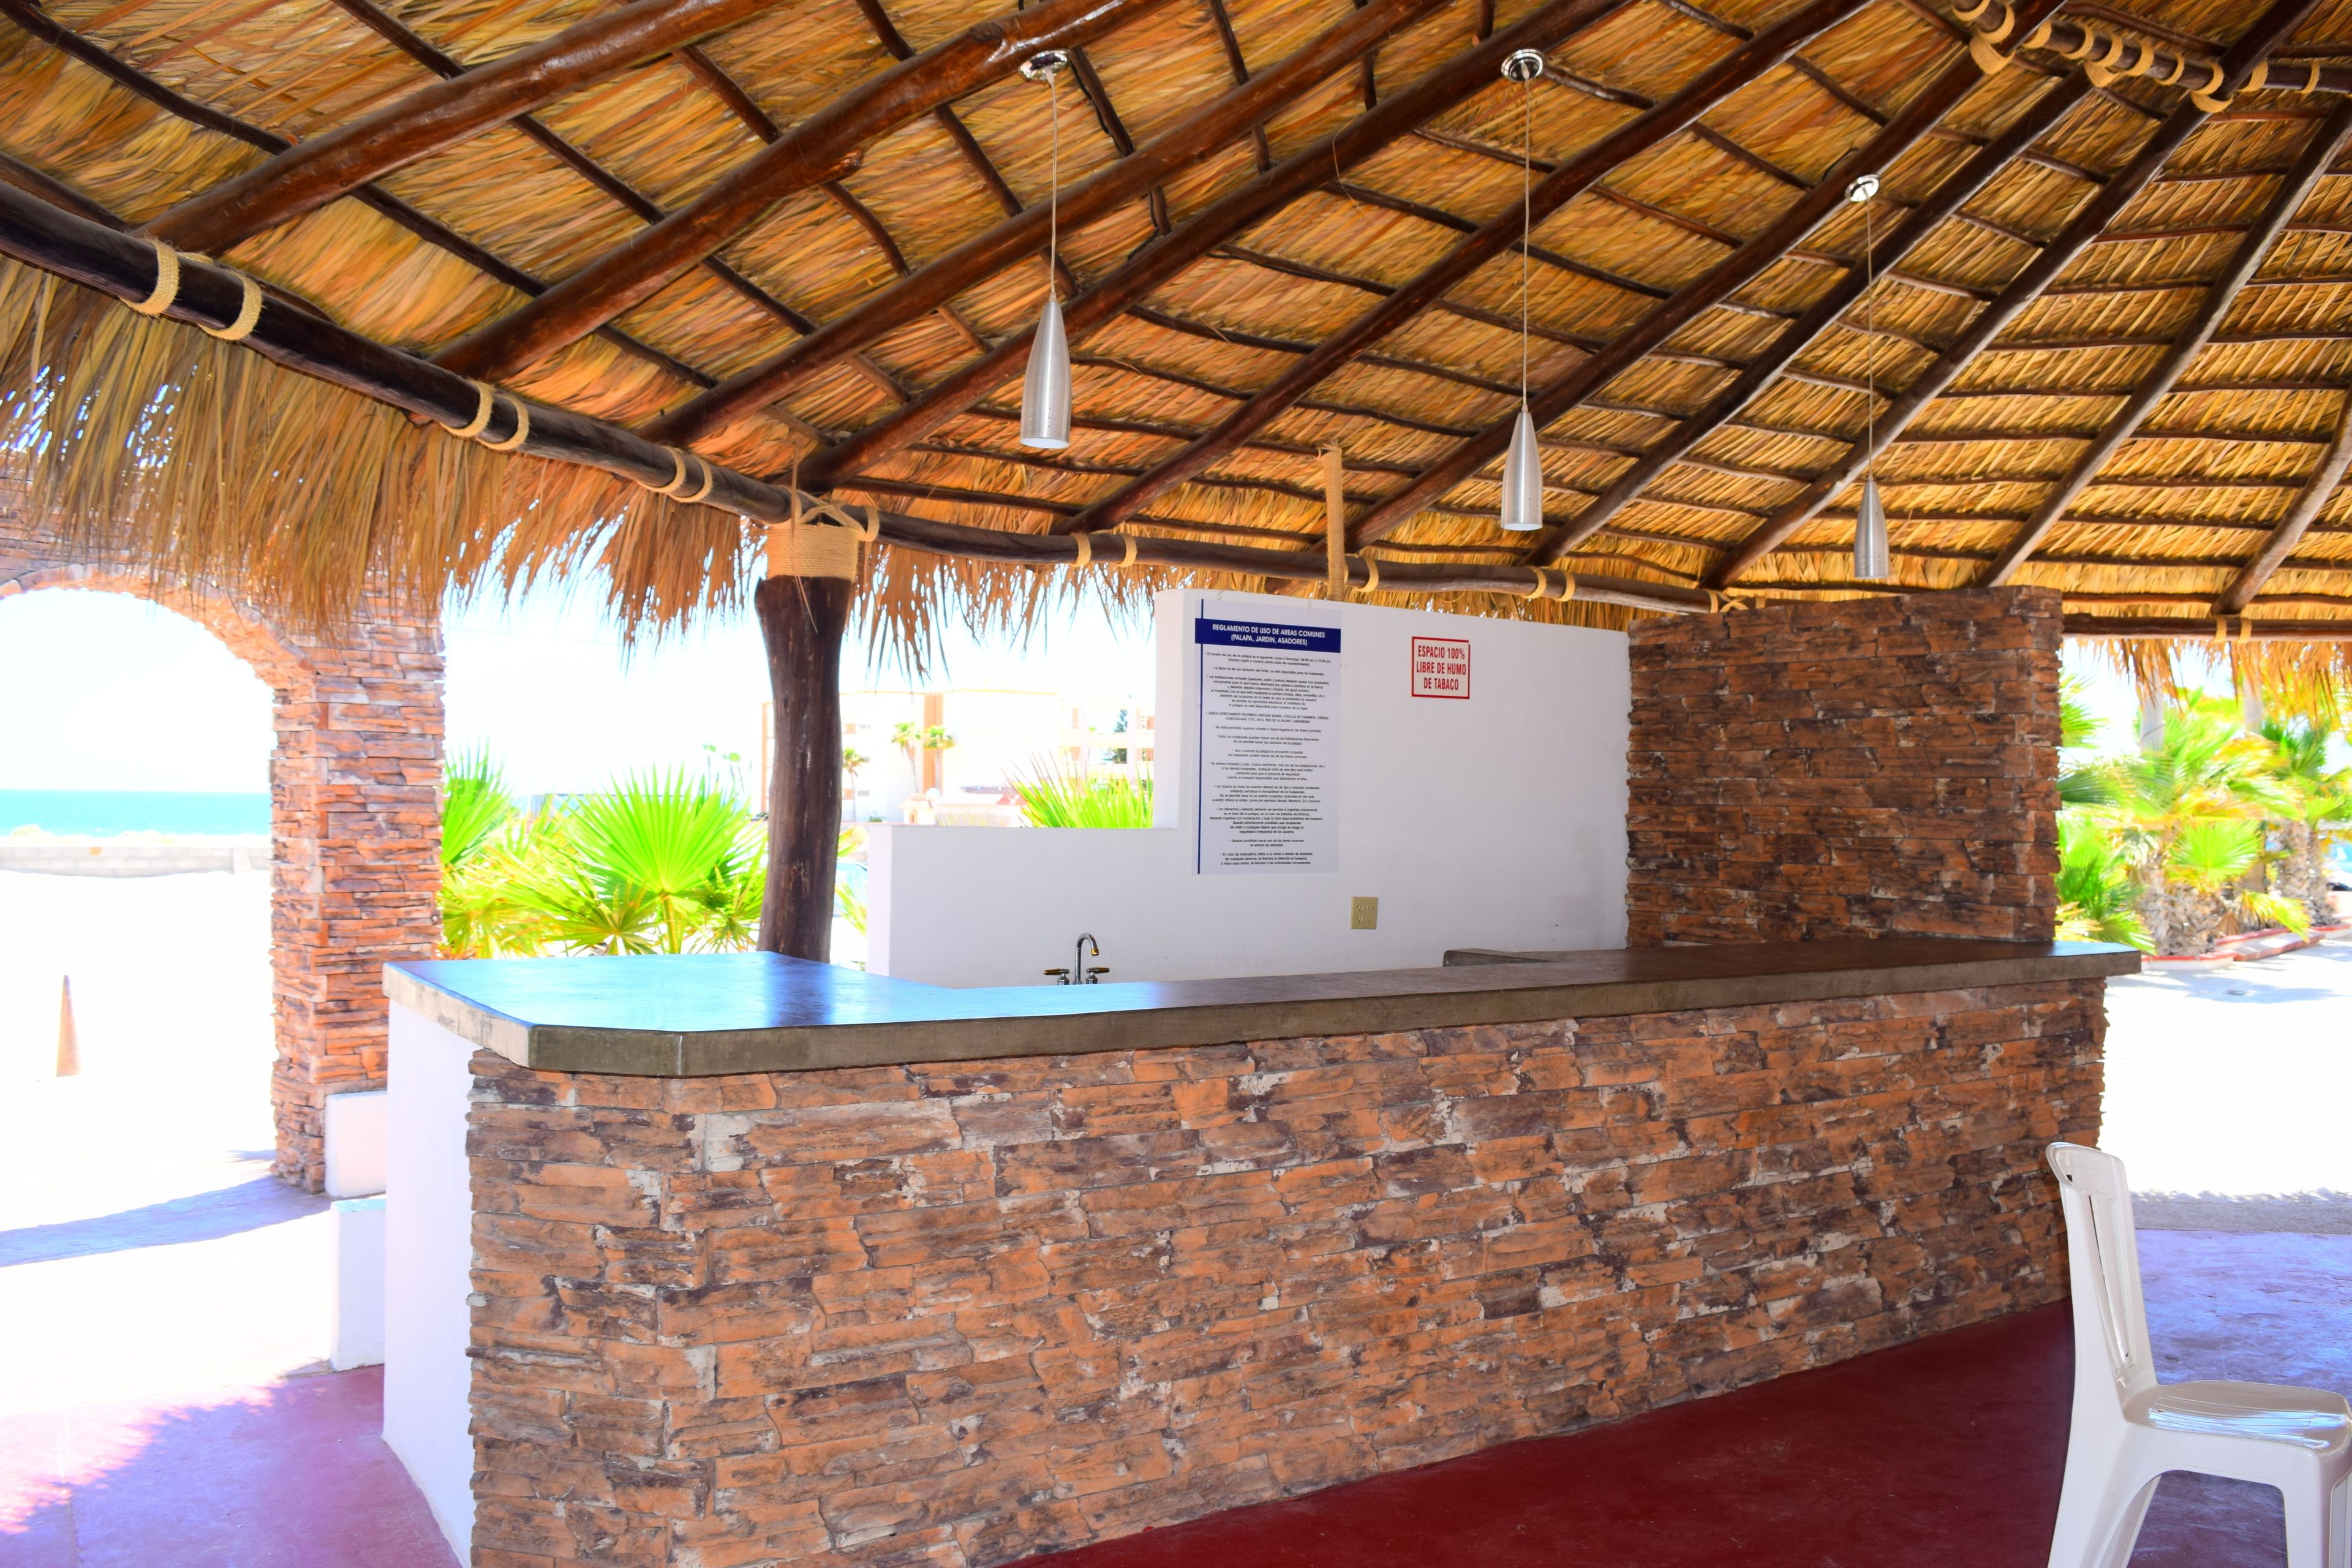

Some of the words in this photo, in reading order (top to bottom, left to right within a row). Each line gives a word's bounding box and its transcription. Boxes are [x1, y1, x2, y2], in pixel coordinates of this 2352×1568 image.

[1212, 624, 1250, 633] REGLAMENTO
[1278, 638, 1308, 646] ASADORES)
[1418, 645, 1445, 658] ESPACIO
[1447, 647, 1465, 660] 100%
[1416, 662, 1434, 674] LIBRE
[1437, 662, 1445, 674] DE
[1447, 663, 1466, 676] HUMO
[1423, 677, 1432, 689] DE
[1434, 677, 1459, 690] TABACO
